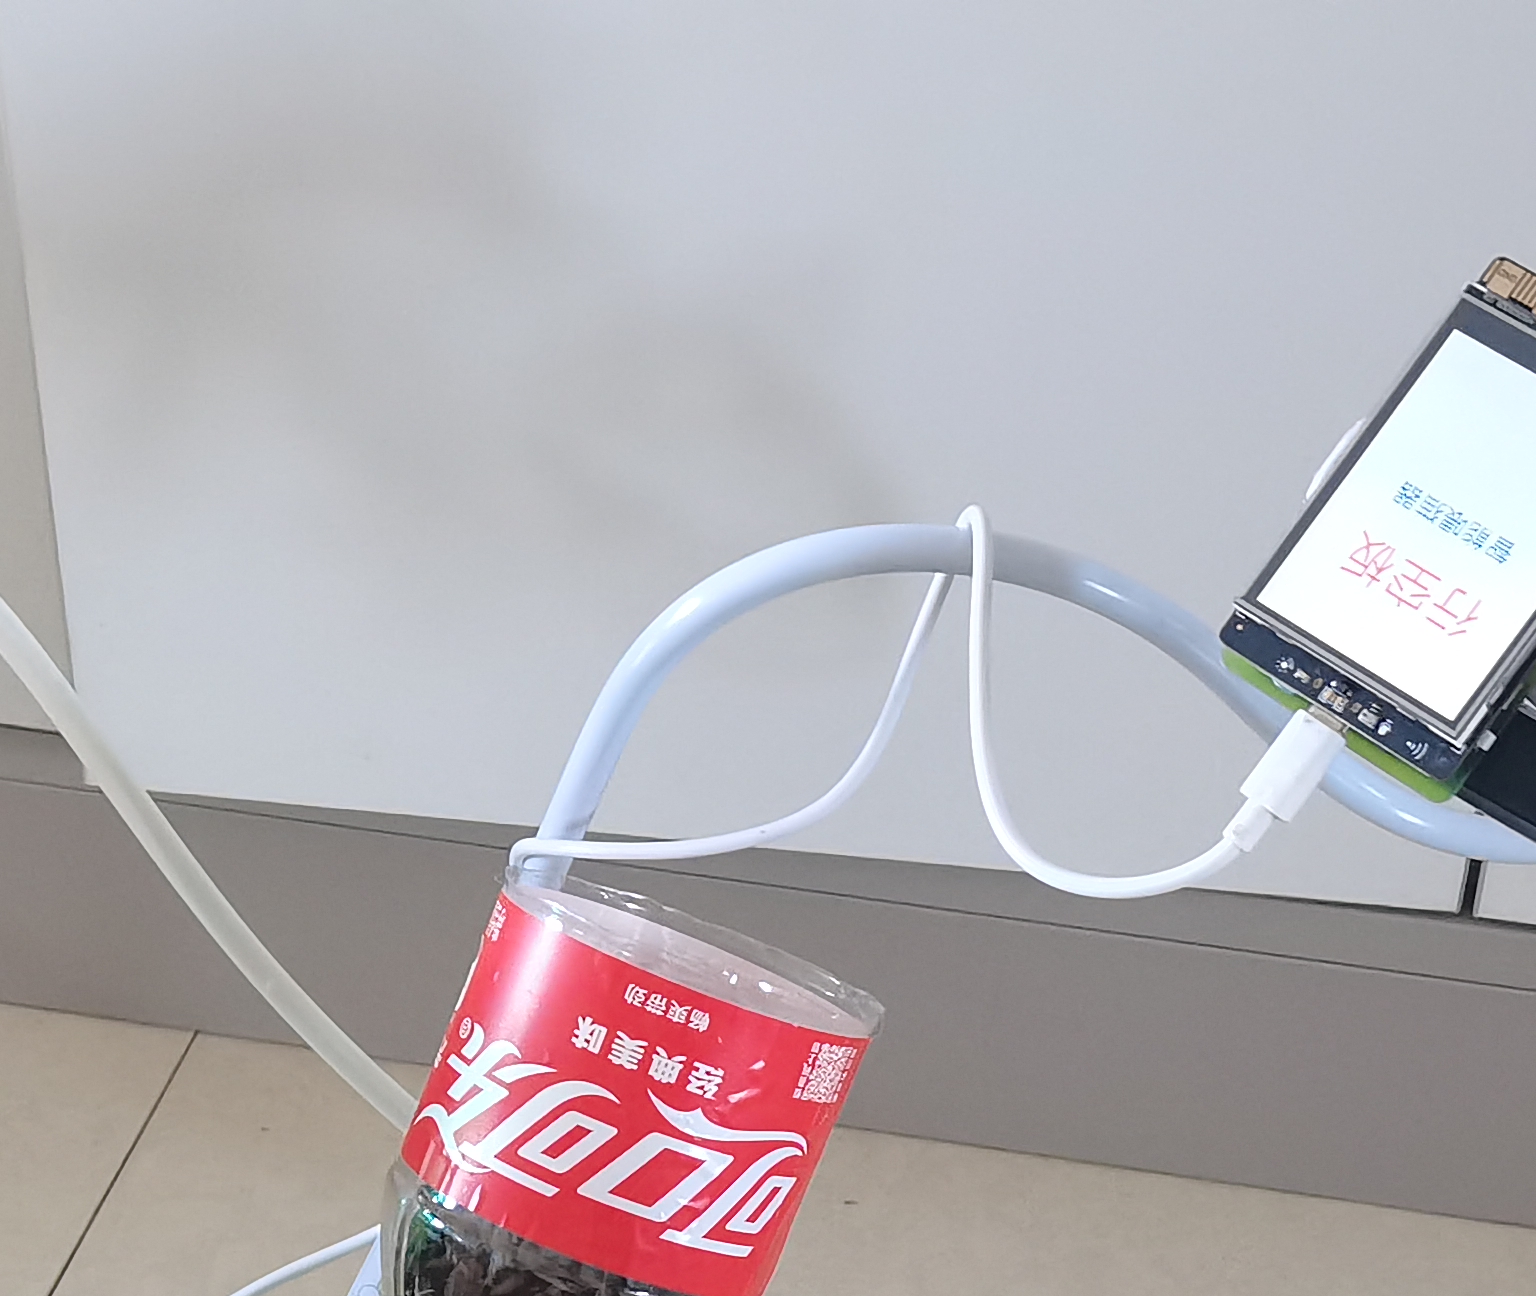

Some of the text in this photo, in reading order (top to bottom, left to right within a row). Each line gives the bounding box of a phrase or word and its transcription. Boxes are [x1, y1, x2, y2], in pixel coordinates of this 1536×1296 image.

[1393, 481, 1515, 564] 智能喂猫器
[1340, 530, 1482, 636] 行空板
[624, 983, 711, 1033] 畅爽带劲
[571, 1015, 726, 1100] 经典美味
[413, 1017, 807, 1257] 可口可乐
